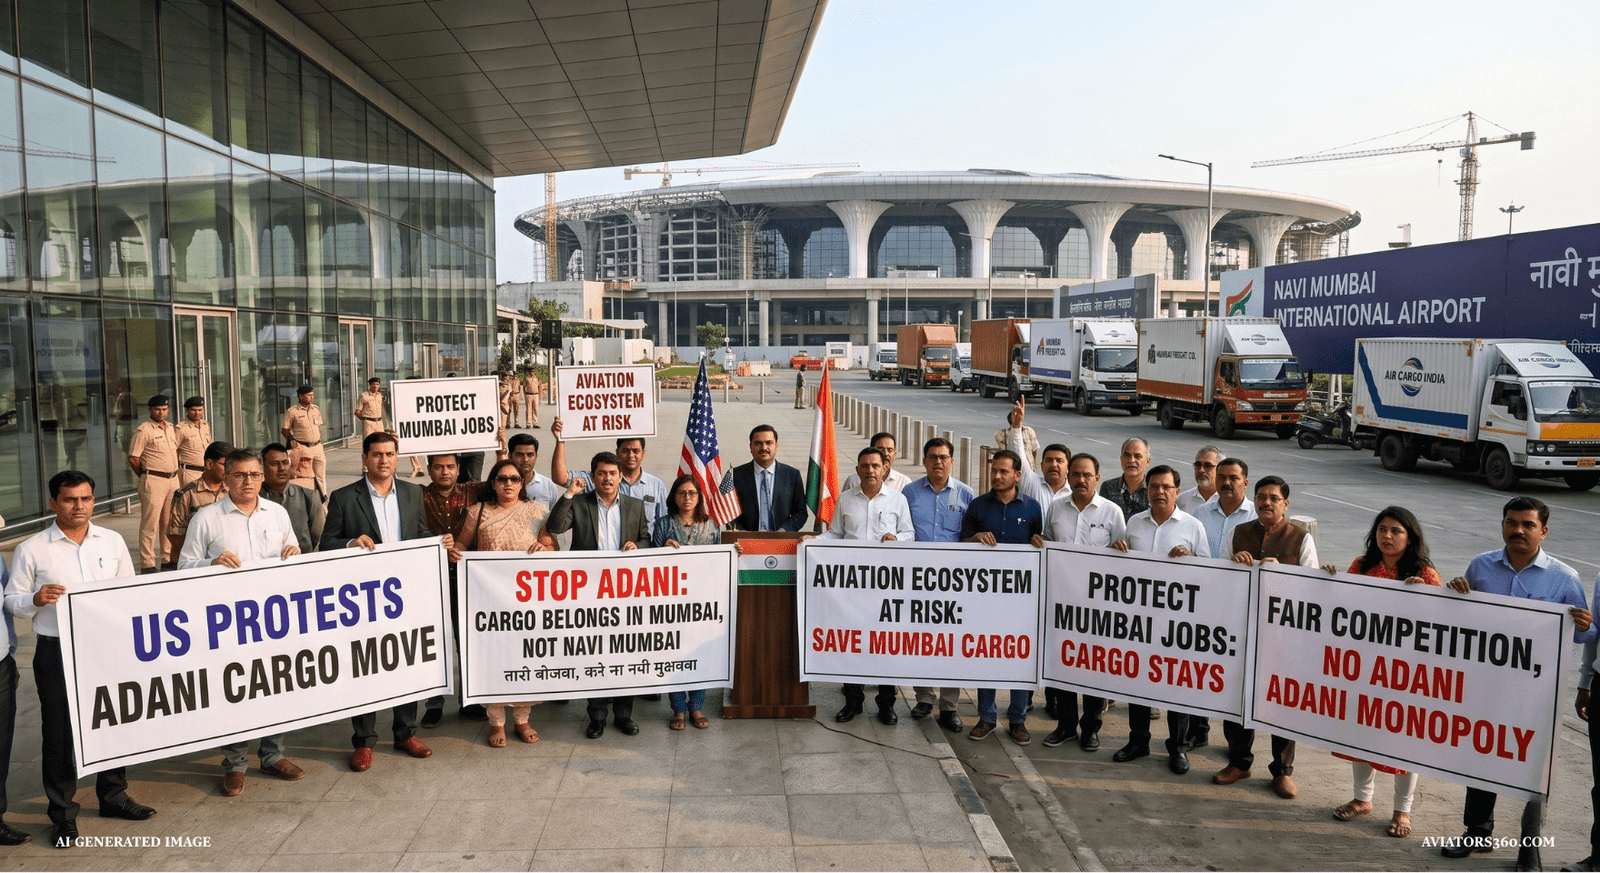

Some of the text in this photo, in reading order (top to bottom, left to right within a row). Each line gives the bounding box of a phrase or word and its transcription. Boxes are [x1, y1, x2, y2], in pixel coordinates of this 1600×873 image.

[1530, 247, 1582, 288] नावी
[1275, 271, 1375, 300] NAVI MUMBAI
[1398, 297, 1485, 324] AIRPORT
[576, 372, 634, 389] AVIATION
[1385, 370, 1445, 384] AIR CARGO INDIA
[416, 394, 476, 413] PROTECT
[568, 393, 644, 410] ECOSYSTEM
[399, 416, 494, 438] MUMBAI JOBS
[582, 415, 631, 431] AT RISK
[516, 566, 687, 602] STOP ADANI:
[813, 565, 1031, 593] AVIATION ECOSYSTEM
[1088, 572, 1200, 613] PROTECT
[132, 577, 403, 662] US PROTESTS
[476, 602, 723, 632] CARGO BELONGS IN MUMBAI,
[879, 599, 962, 624] AT RISK:
[523, 631, 680, 658] NOT NAVI MUMBAI
[813, 628, 1030, 659] SAVE MUMBAI CARGO
[1054, 603, 1236, 656] MUMBAI JOBS:
[1268, 596, 1542, 678] FAIR COMPETITION,
[92, 625, 436, 730] ADANI CARGO MOVE
[1062, 640, 1224, 692] CARGO STAYS
[1323, 646, 1465, 703] NO ADANI
[1266, 674, 1535, 762] ADANI MONOPOLY
